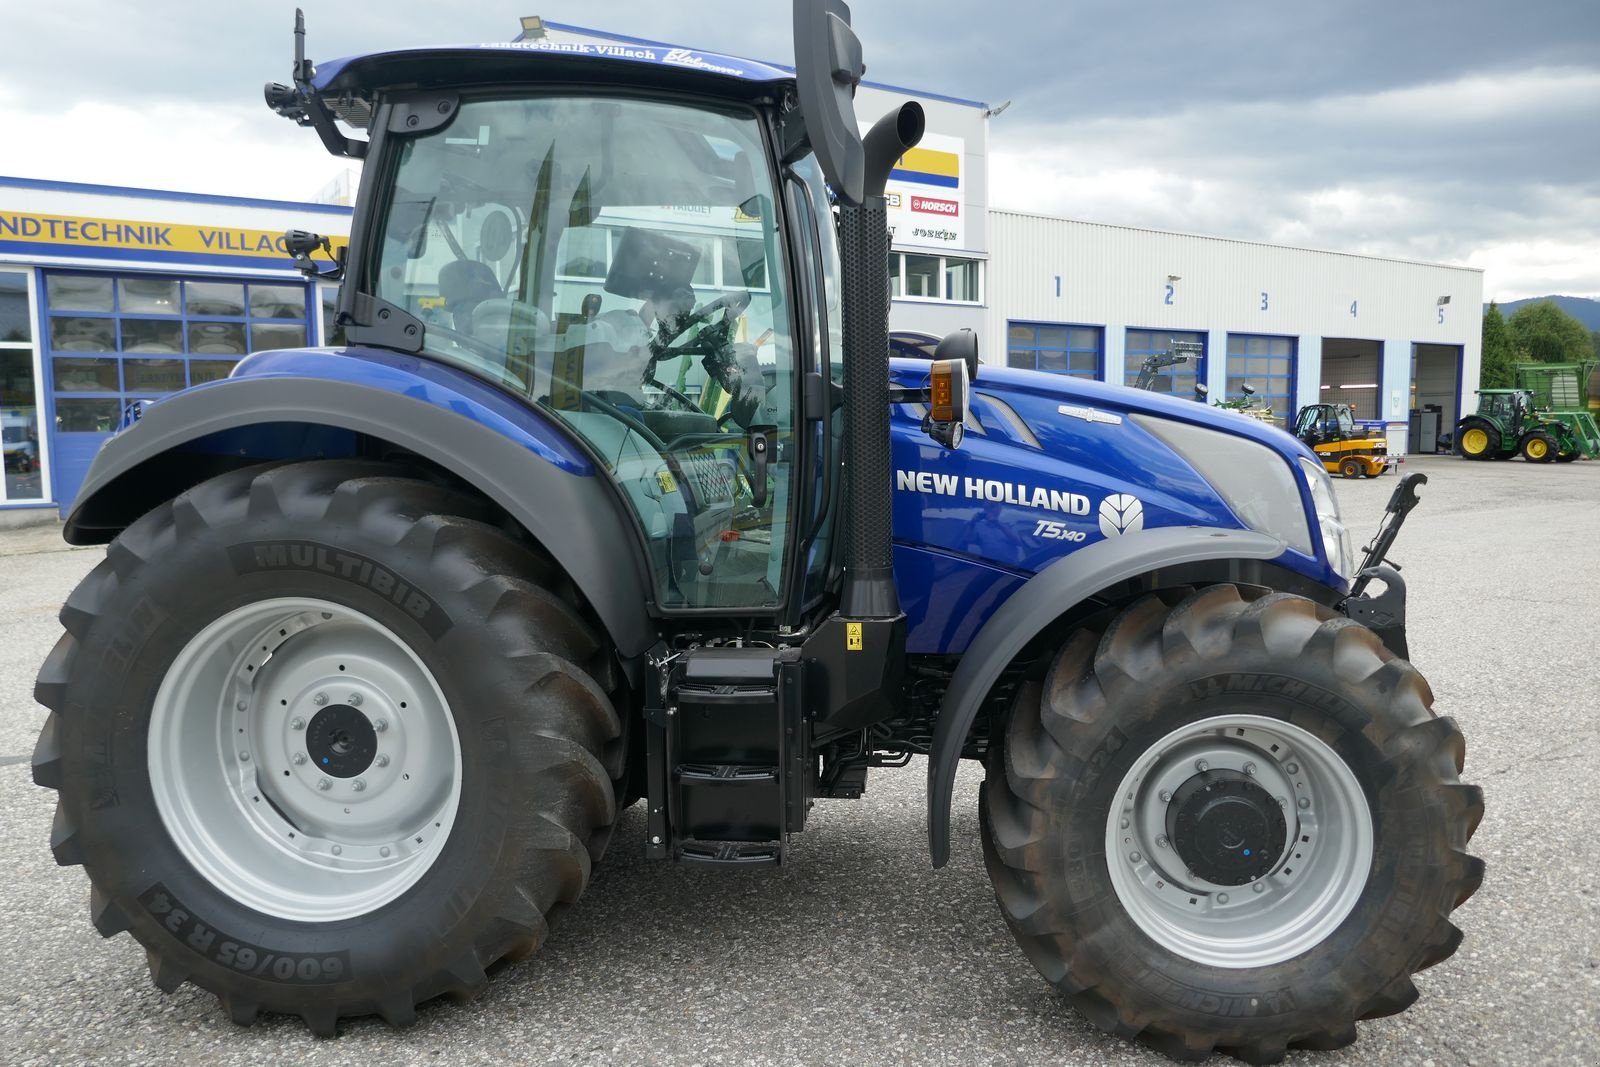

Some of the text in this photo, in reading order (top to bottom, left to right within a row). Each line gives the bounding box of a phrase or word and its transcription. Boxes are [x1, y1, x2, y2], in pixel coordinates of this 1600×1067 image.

[884, 194, 900, 207] CB
[921, 200, 957, 213] HORSCH
[0, 216, 288, 254] NDTECHNIK VILLAC
[912, 227, 958, 241] JOSKIN
[1054, 275, 1061, 298] 1
[1164, 284, 1174, 305] 2
[1260, 292, 1269, 311] 3
[1350, 300, 1358, 318] 4
[1437, 308, 1444, 324] 5
[896, 469, 1092, 517] NEW HOLLAND
[1032, 519, 1087, 543] T5.140
[187, 922, 217, 954] R
[216, 940, 345, 981] 600/65
